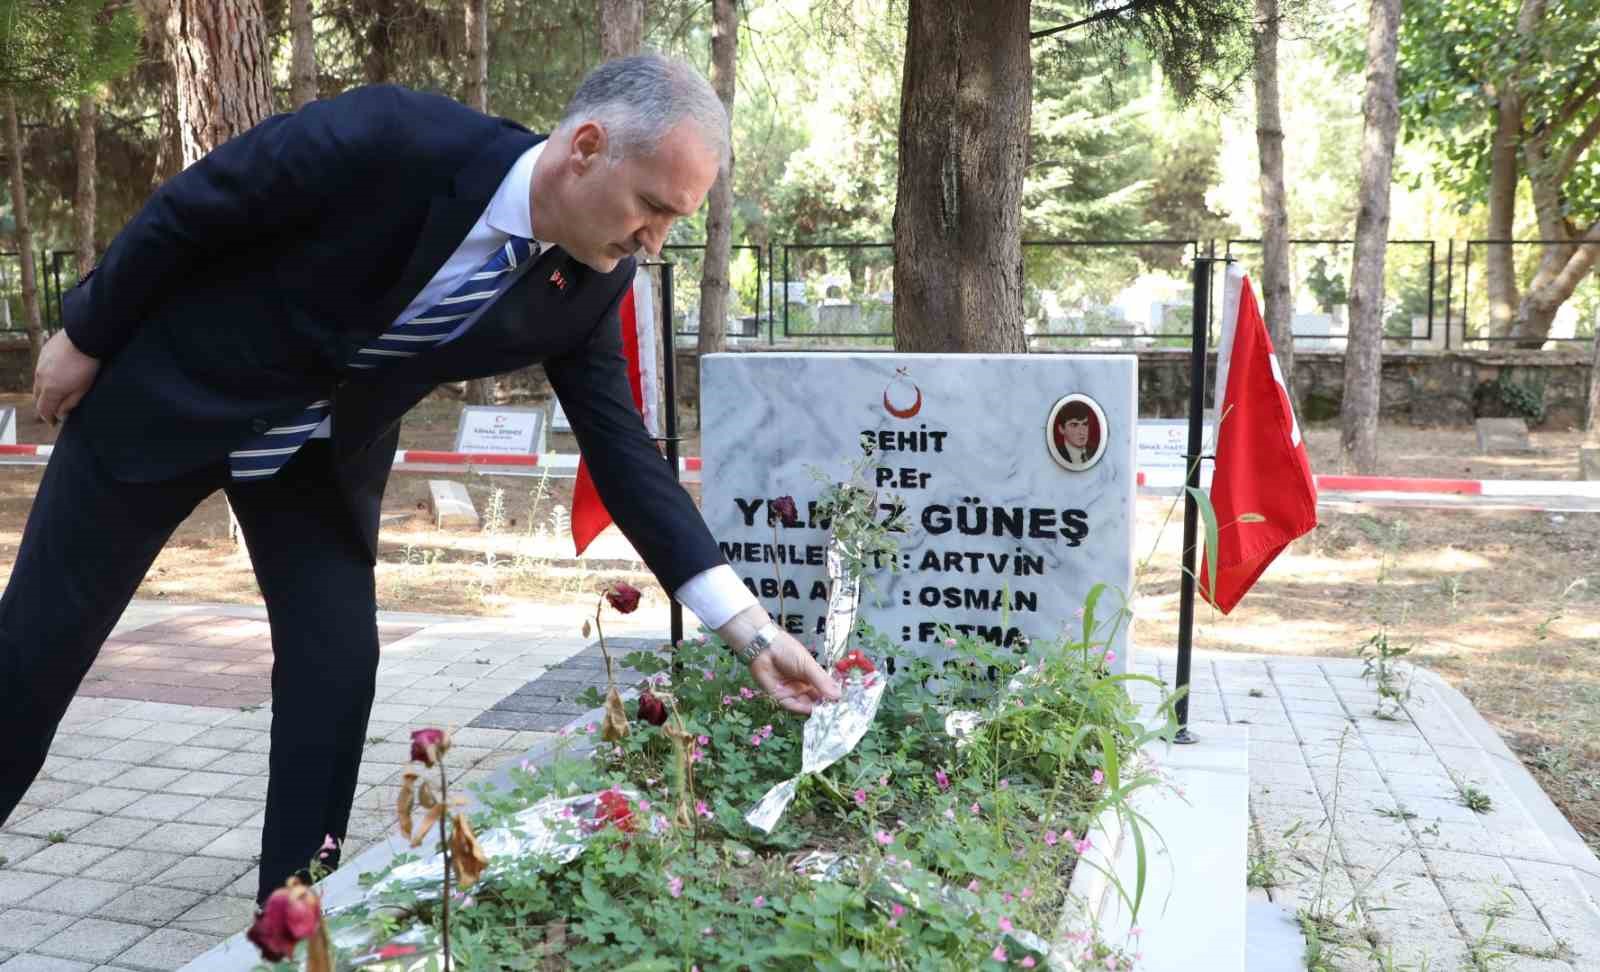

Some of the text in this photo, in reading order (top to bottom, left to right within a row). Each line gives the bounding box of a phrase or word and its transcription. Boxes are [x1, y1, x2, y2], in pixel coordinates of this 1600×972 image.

[876, 467, 932, 489] P.Er
[921, 496, 1089, 547] GÜNEŞ
[919, 547, 1044, 577] ARTVİN
[742, 577, 800, 600] ABA
[919, 586, 1038, 612] OSMAN
